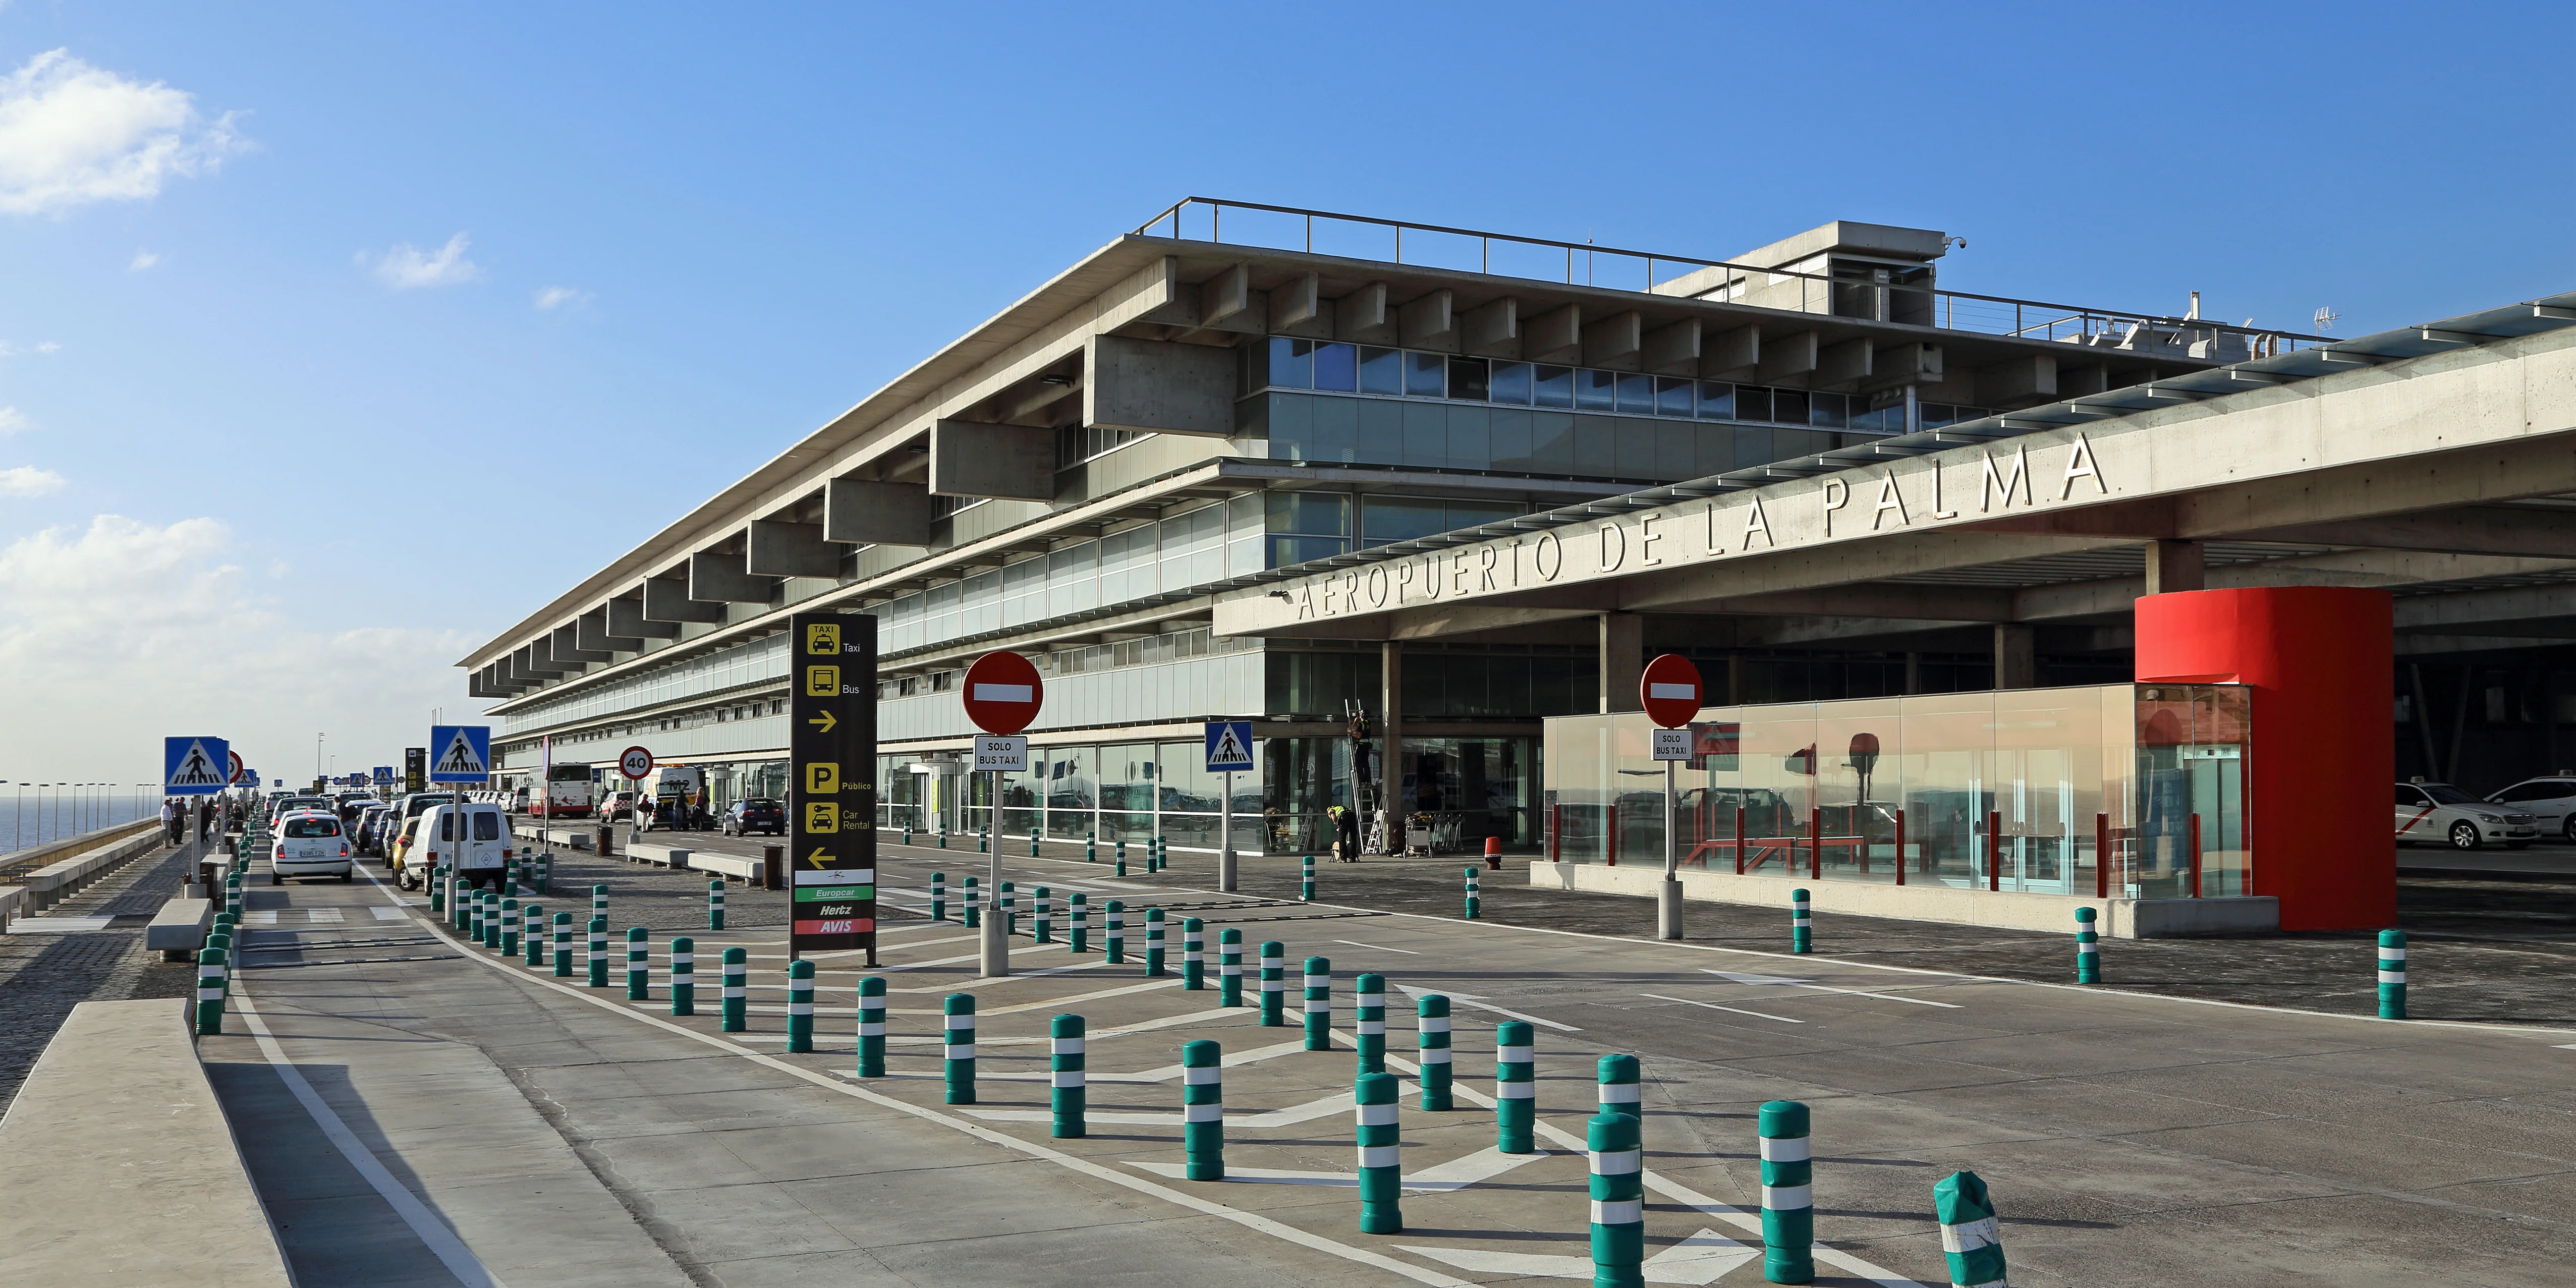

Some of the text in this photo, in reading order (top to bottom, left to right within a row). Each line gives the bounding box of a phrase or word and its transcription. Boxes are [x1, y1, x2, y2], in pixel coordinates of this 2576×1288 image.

[1298, 431, 2106, 621] AEROPUERTO DE LA PALMA
[843, 643, 860, 652] Taxi
[843, 685, 859, 694] Bus
[987, 743, 1012, 751] SOLO
[626, 758, 646, 769] 40
[979, 756, 1019, 764] BUS TAXI
[814, 767, 832, 789] P
[843, 810, 858, 819] Car
[843, 821, 870, 829] Rental
[816, 889, 855, 898] Europcar
[820, 905, 852, 916] Hertz
[820, 920, 852, 932] AVIS
